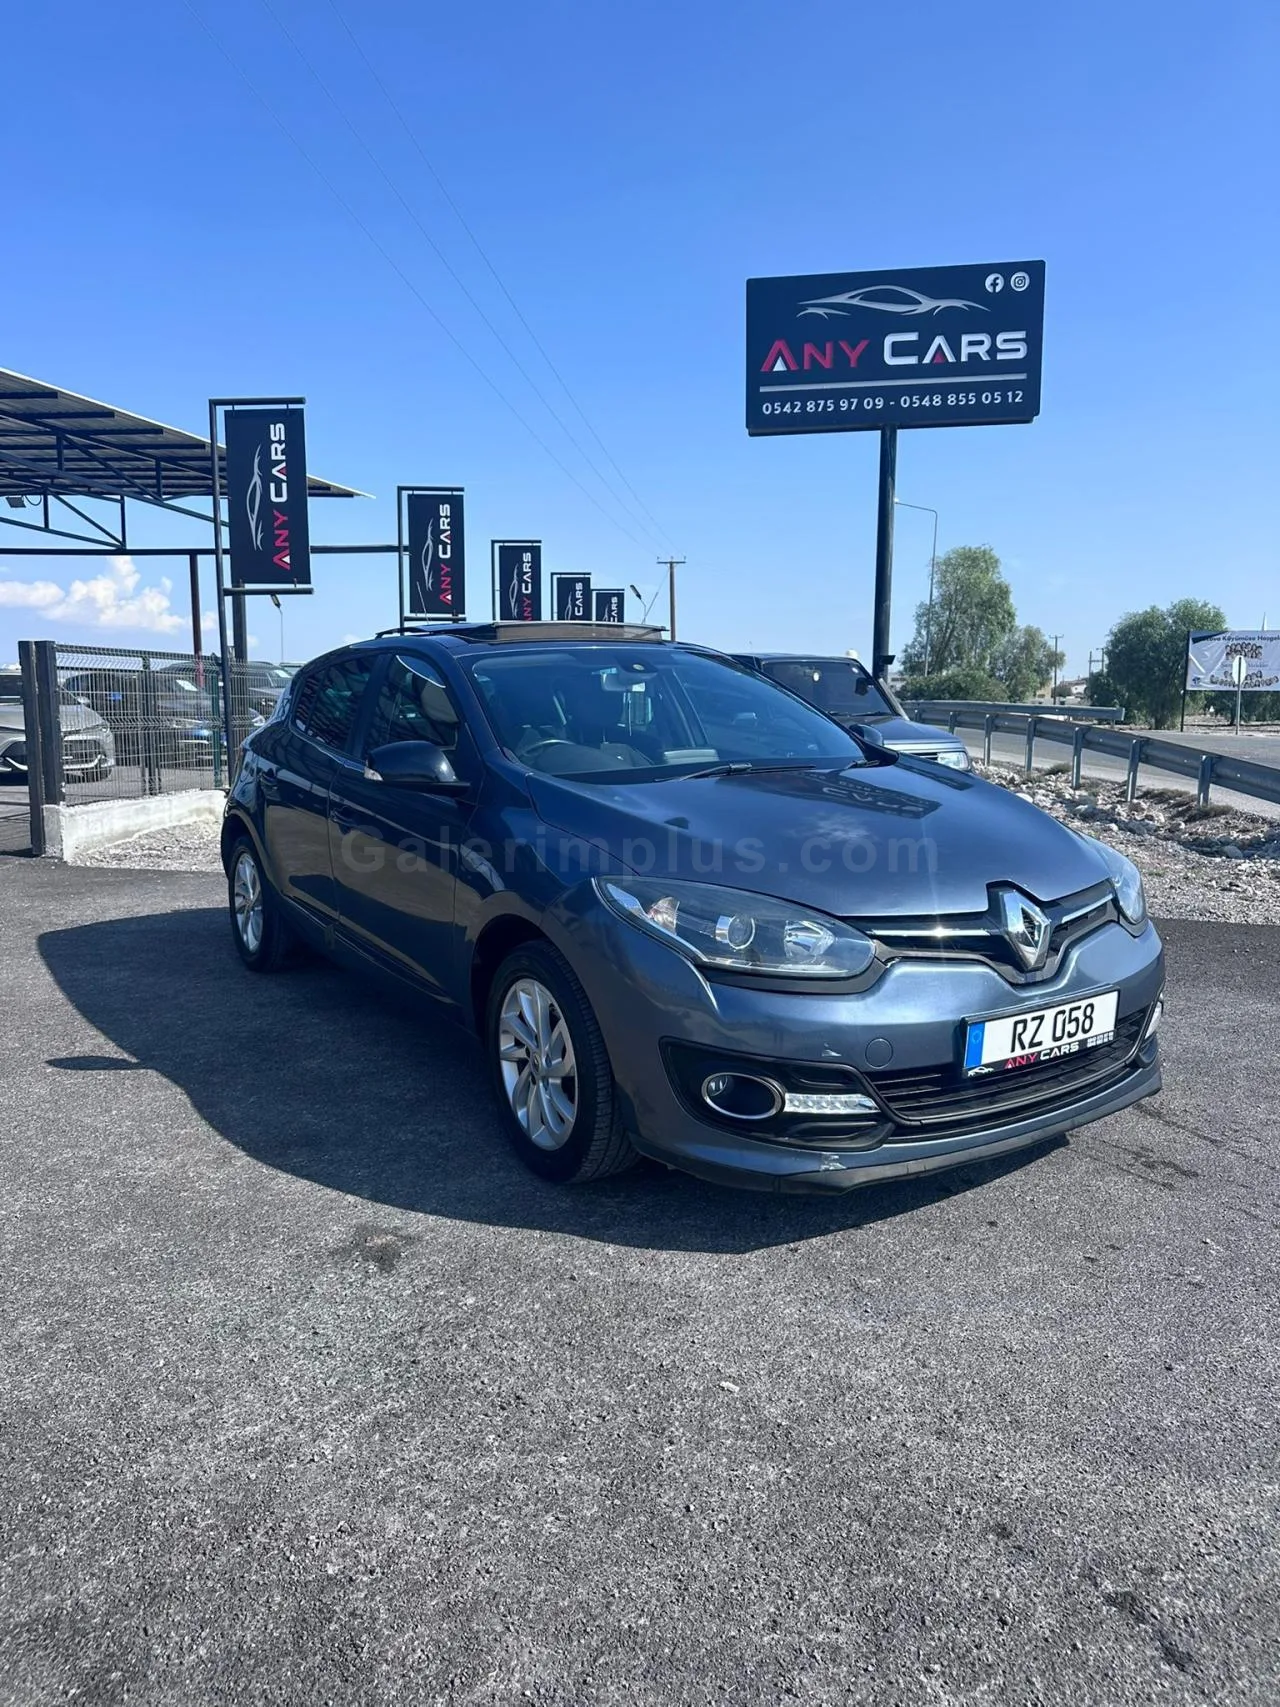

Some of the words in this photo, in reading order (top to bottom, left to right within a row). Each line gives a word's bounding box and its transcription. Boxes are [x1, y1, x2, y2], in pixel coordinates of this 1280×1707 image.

[761, 339, 870, 372] ANY
[883, 331, 1028, 366] CARS
[762, 401, 803, 414] 0542
[807, 399, 836, 412] 875
[840, 397, 858, 410] 97
[863, 396, 884, 409] 09
[901, 394, 942, 408] 0548
[947, 393, 977, 406] 855
[982, 391, 1002, 404] 05
[1007, 390, 1024, 404] 12
[270, 423, 288, 503] CARS
[273, 510, 291, 570] ANY
[438, 503, 451, 559] CARS
[439, 564, 452, 605] ANY
[522, 552, 532, 594] CARS
[574, 582, 584, 616] CARS
[1010, 1014, 1045, 1053] RZ
[1052, 1002, 1095, 1042] 058
[1004, 1053, 1039, 1069] ANY
[1040, 1041, 1079, 1060] CARS
